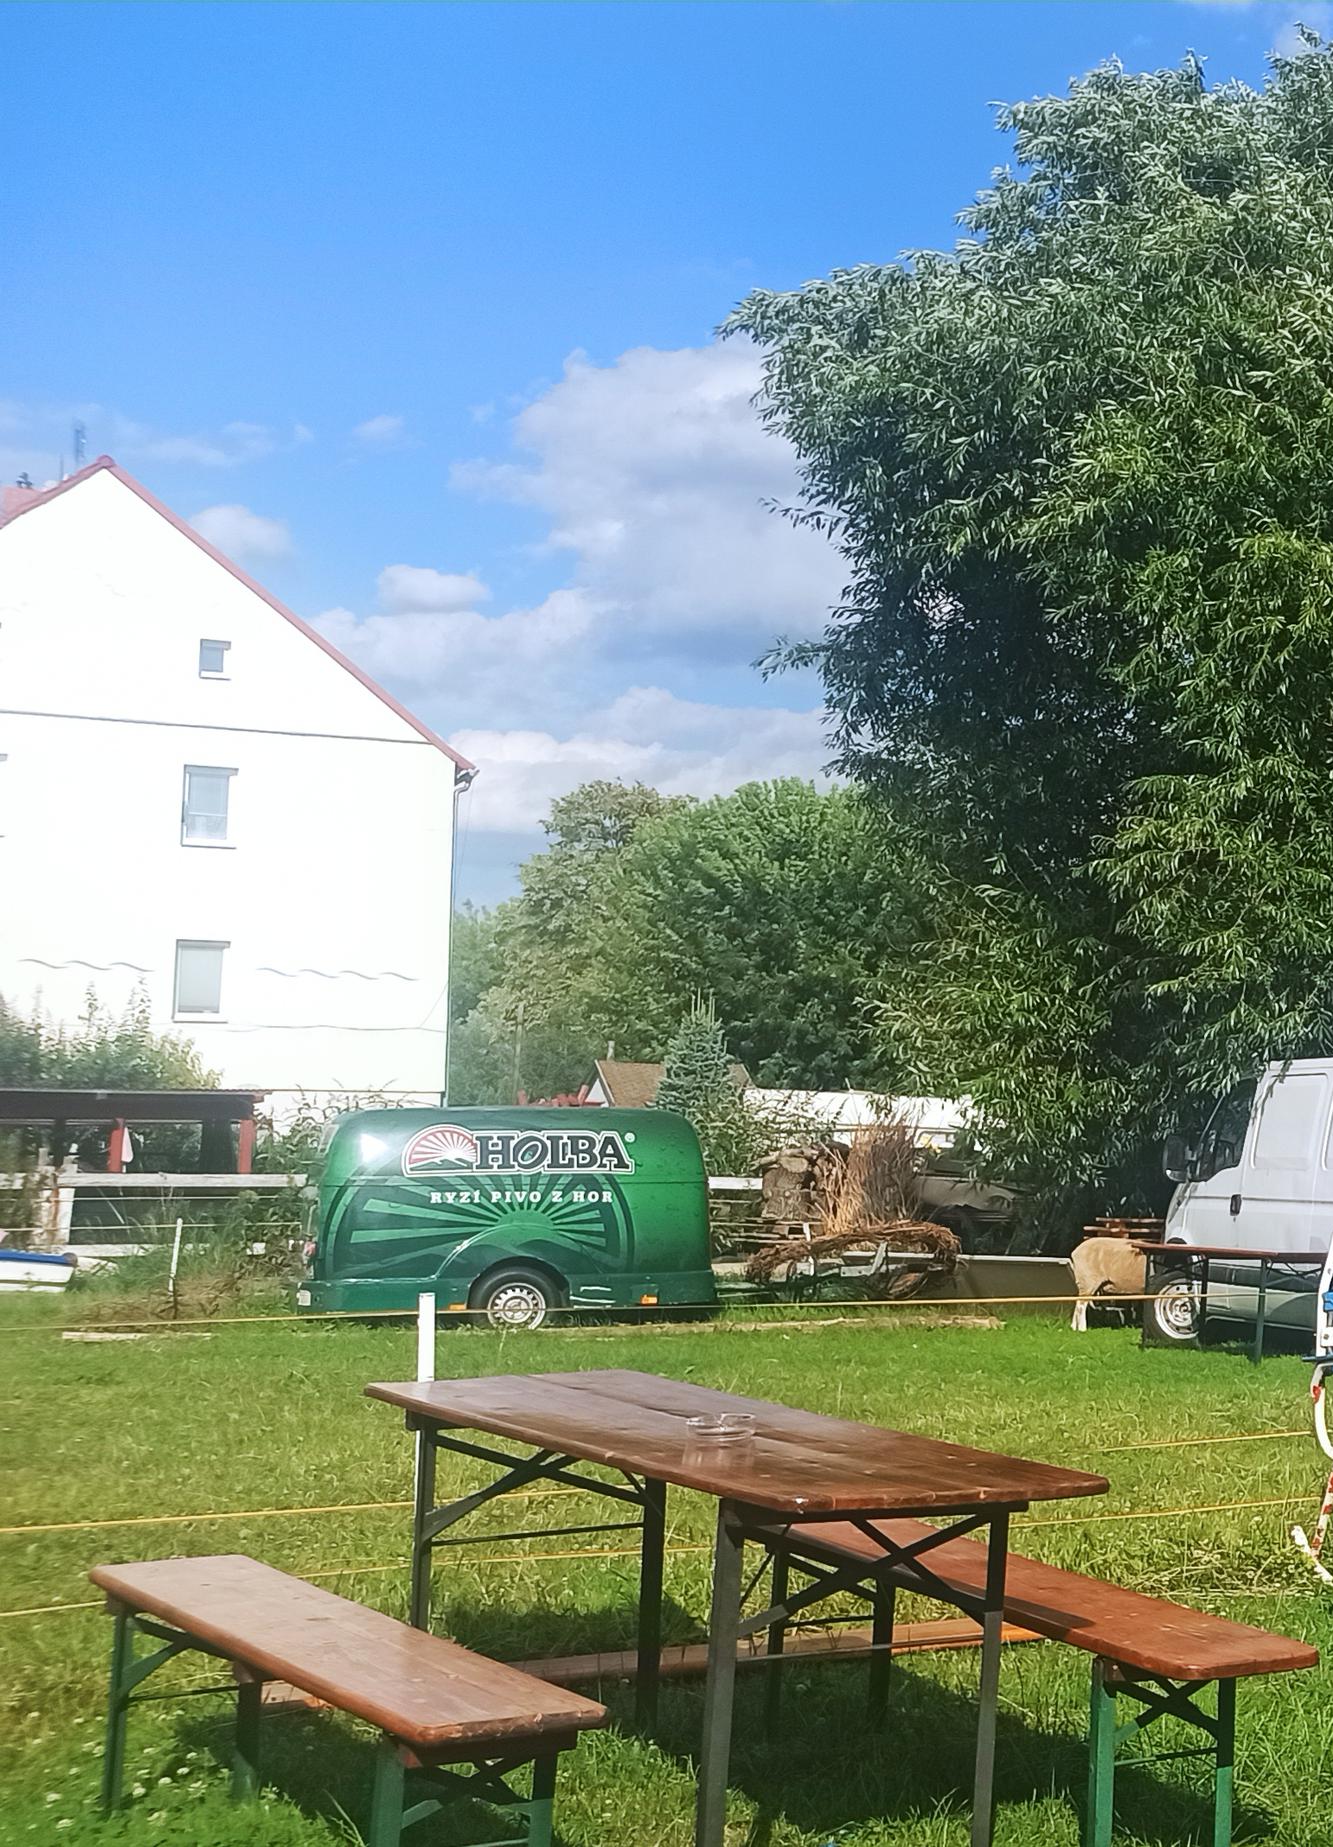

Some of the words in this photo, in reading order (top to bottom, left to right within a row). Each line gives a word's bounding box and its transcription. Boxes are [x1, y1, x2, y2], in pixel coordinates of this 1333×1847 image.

[474, 1131, 634, 1174] HOLBA
[430, 1189, 481, 1203] RYZÍ
[491, 1191, 541, 1203] PIVO
[552, 1191, 563, 1203] Z
[573, 1191, 613, 1203] HOR
